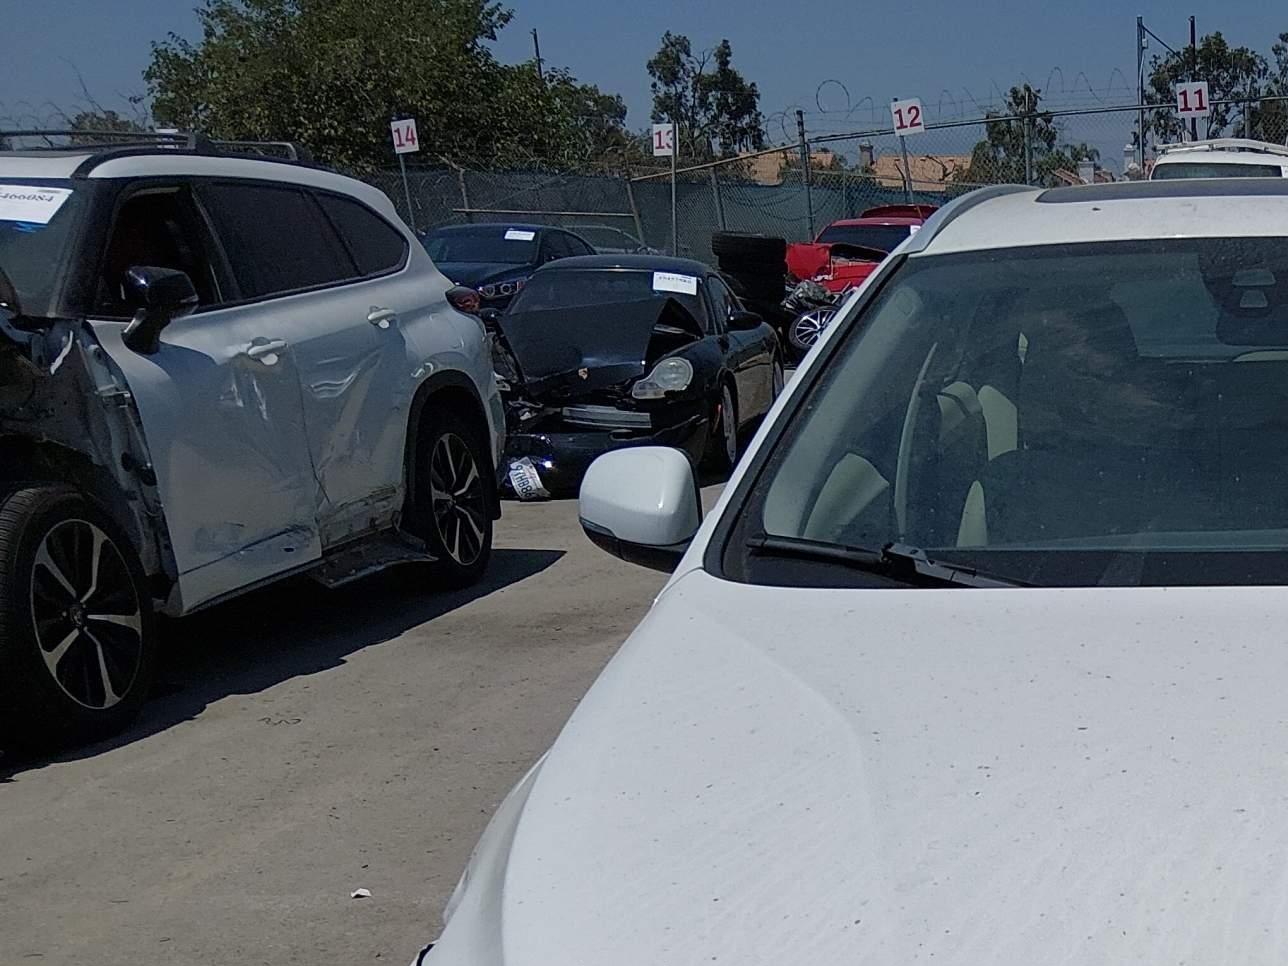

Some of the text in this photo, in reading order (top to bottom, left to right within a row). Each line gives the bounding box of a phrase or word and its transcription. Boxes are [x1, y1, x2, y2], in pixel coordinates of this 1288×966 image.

[1178, 88, 1208, 112] 11
[895, 105, 922, 130] 12
[393, 125, 417, 148] 14
